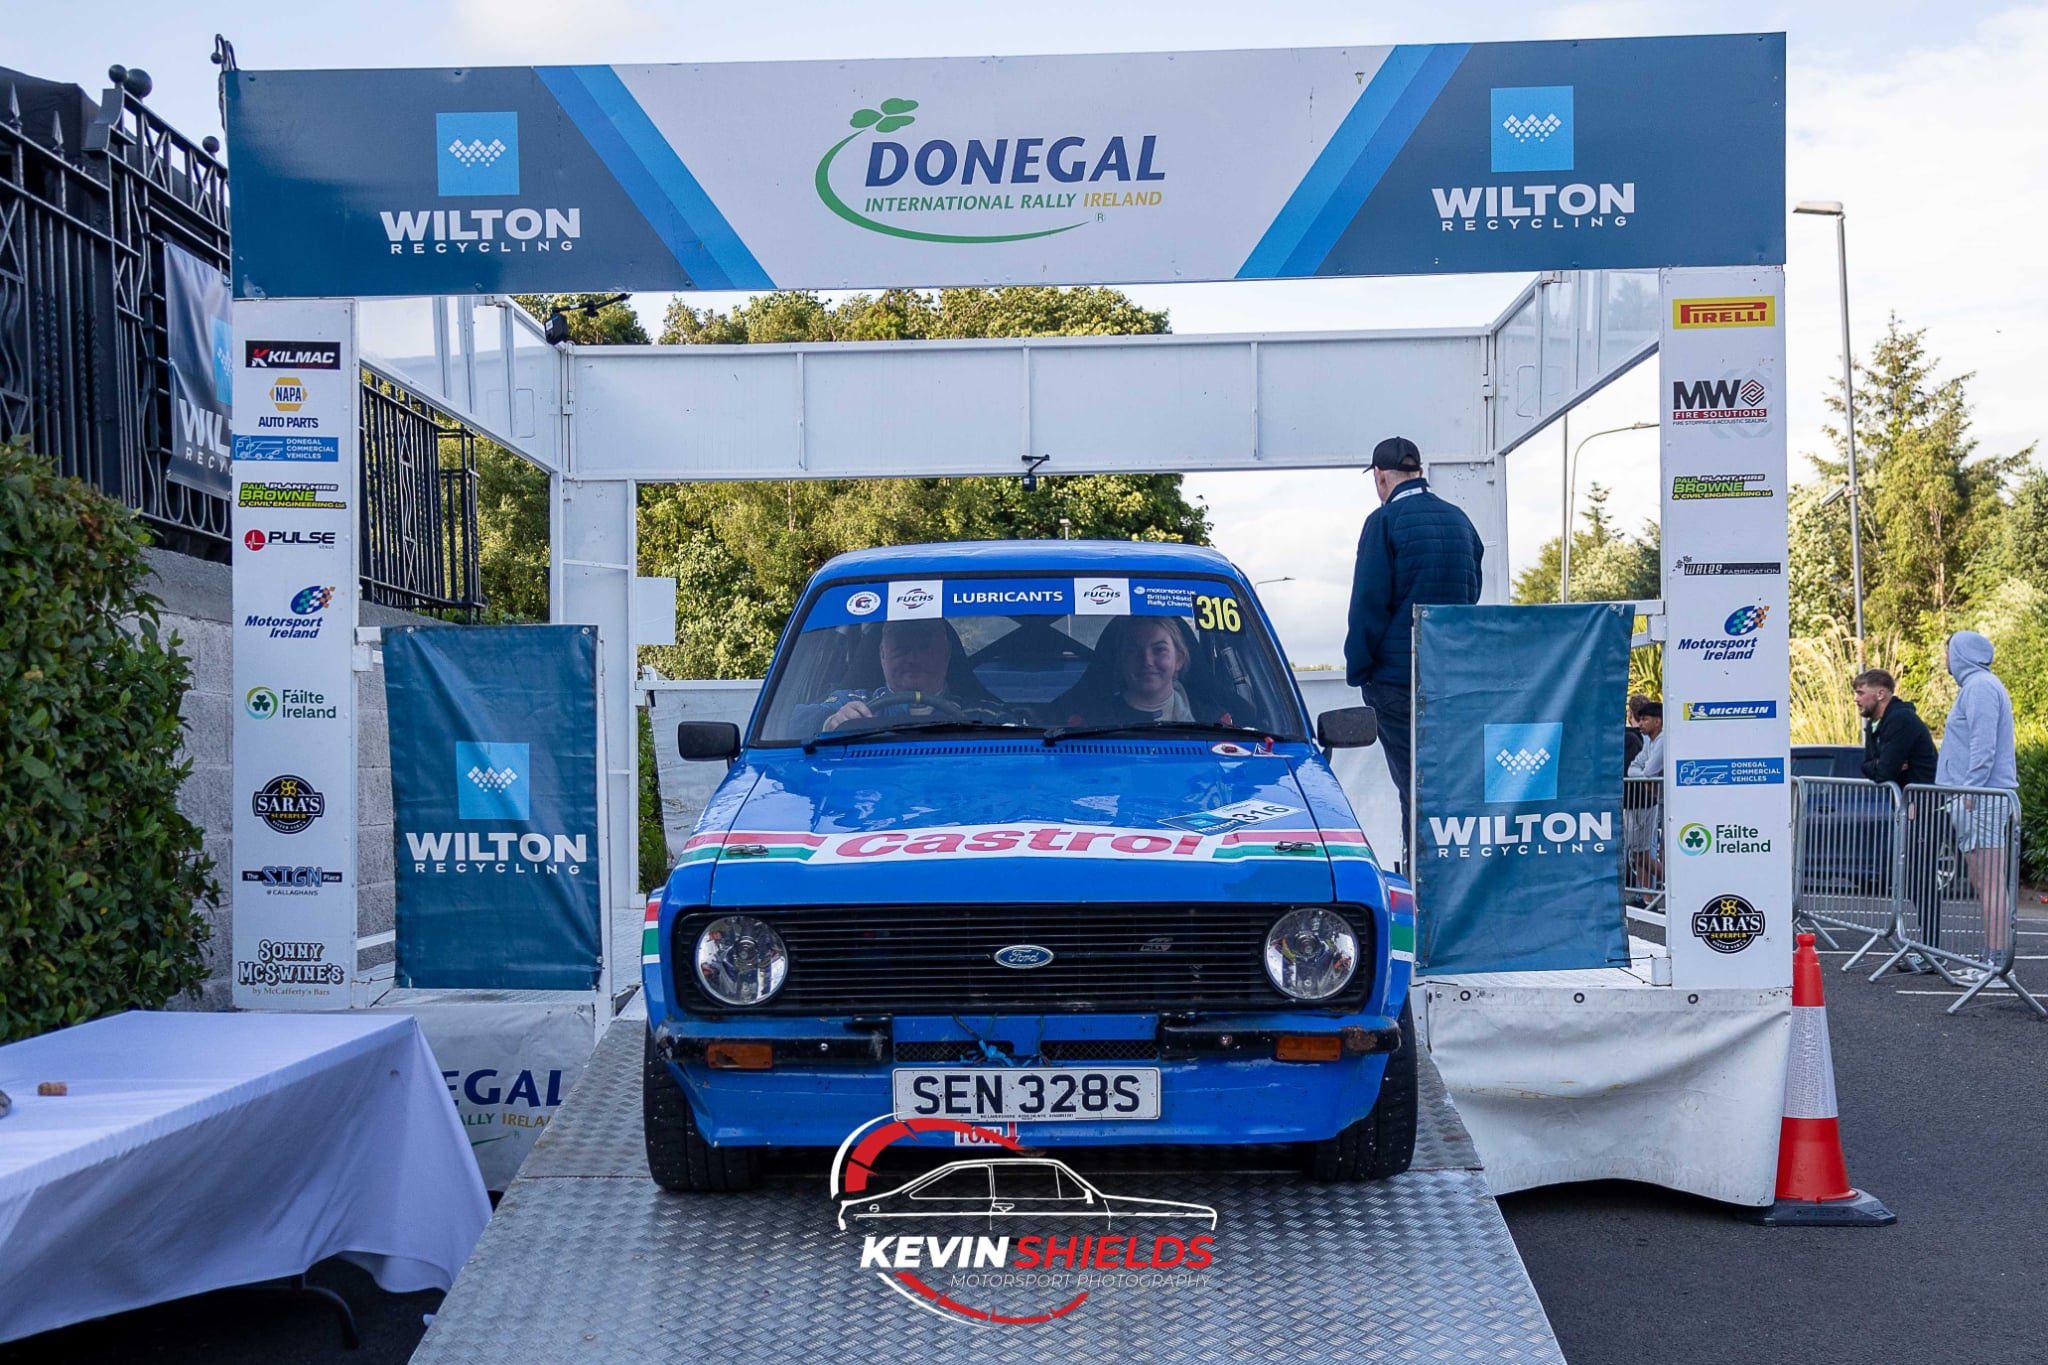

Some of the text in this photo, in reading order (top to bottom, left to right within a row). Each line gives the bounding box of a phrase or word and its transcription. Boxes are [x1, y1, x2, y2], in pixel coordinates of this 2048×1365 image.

[865, 135, 1165, 187] DONEGAL
[865, 190, 1162, 213] INTERNATIONAL RALLY IRELAND
[1431, 182, 1635, 218] WILTON
[380, 207, 580, 242] WILTON
[1442, 215, 1627, 231] RECYCLING
[391, 241, 574, 254] RECYCLING
[1680, 302, 1767, 324] PIRELLI
[268, 351, 335, 363] KILMAC
[275, 386, 302, 402] NAPA
[1673, 379, 1742, 410] MW
[1675, 409, 1766, 419] FIRE SOLUTIONS
[179, 398, 232, 457] WIL
[258, 416, 319, 429] AUTO PARTS
[241, 482, 267, 490] PAUL
[1674, 482, 1744, 493] BROWNE
[239, 490, 315, 501] BROWNE
[268, 531, 336, 544] PULSE
[896, 594, 933, 603] FUCHS
[953, 591, 1063, 604] LUBRICANTS
[1083, 590, 1121, 598] FUCHS
[1146, 587, 1186, 595] motorsport
[1196, 595, 1241, 632] 316
[245, 615, 323, 629] Motorsport
[269, 627, 319, 638] Ireland
[1678, 637, 1757, 651] Motorsport
[1703, 649, 1754, 660] Ireland
[282, 689, 324, 704] Fáilte
[282, 706, 336, 718] Ireland
[1709, 706, 1769, 715] MICHELIN
[257, 796, 320, 812] SARA'S
[1232, 805, 1290, 821] 316
[1428, 812, 1612, 846] WILTON
[1716, 824, 1758, 839] Fáilte
[405, 832, 587, 863] WILTON
[835, 828, 1204, 857] castrol
[1716, 839, 1771, 853] Ireland
[1438, 843, 1605, 858] RECYCLING
[261, 866, 323, 887] SIGN
[323, 873, 340, 881] Place
[415, 863, 580, 875] RECYCLING
[1696, 916, 1761, 932] SARA'S
[258, 939, 324, 961] SONNY
[1008, 949, 1040, 963] Ford
[913, 1073, 1140, 1115] SEN 328S
